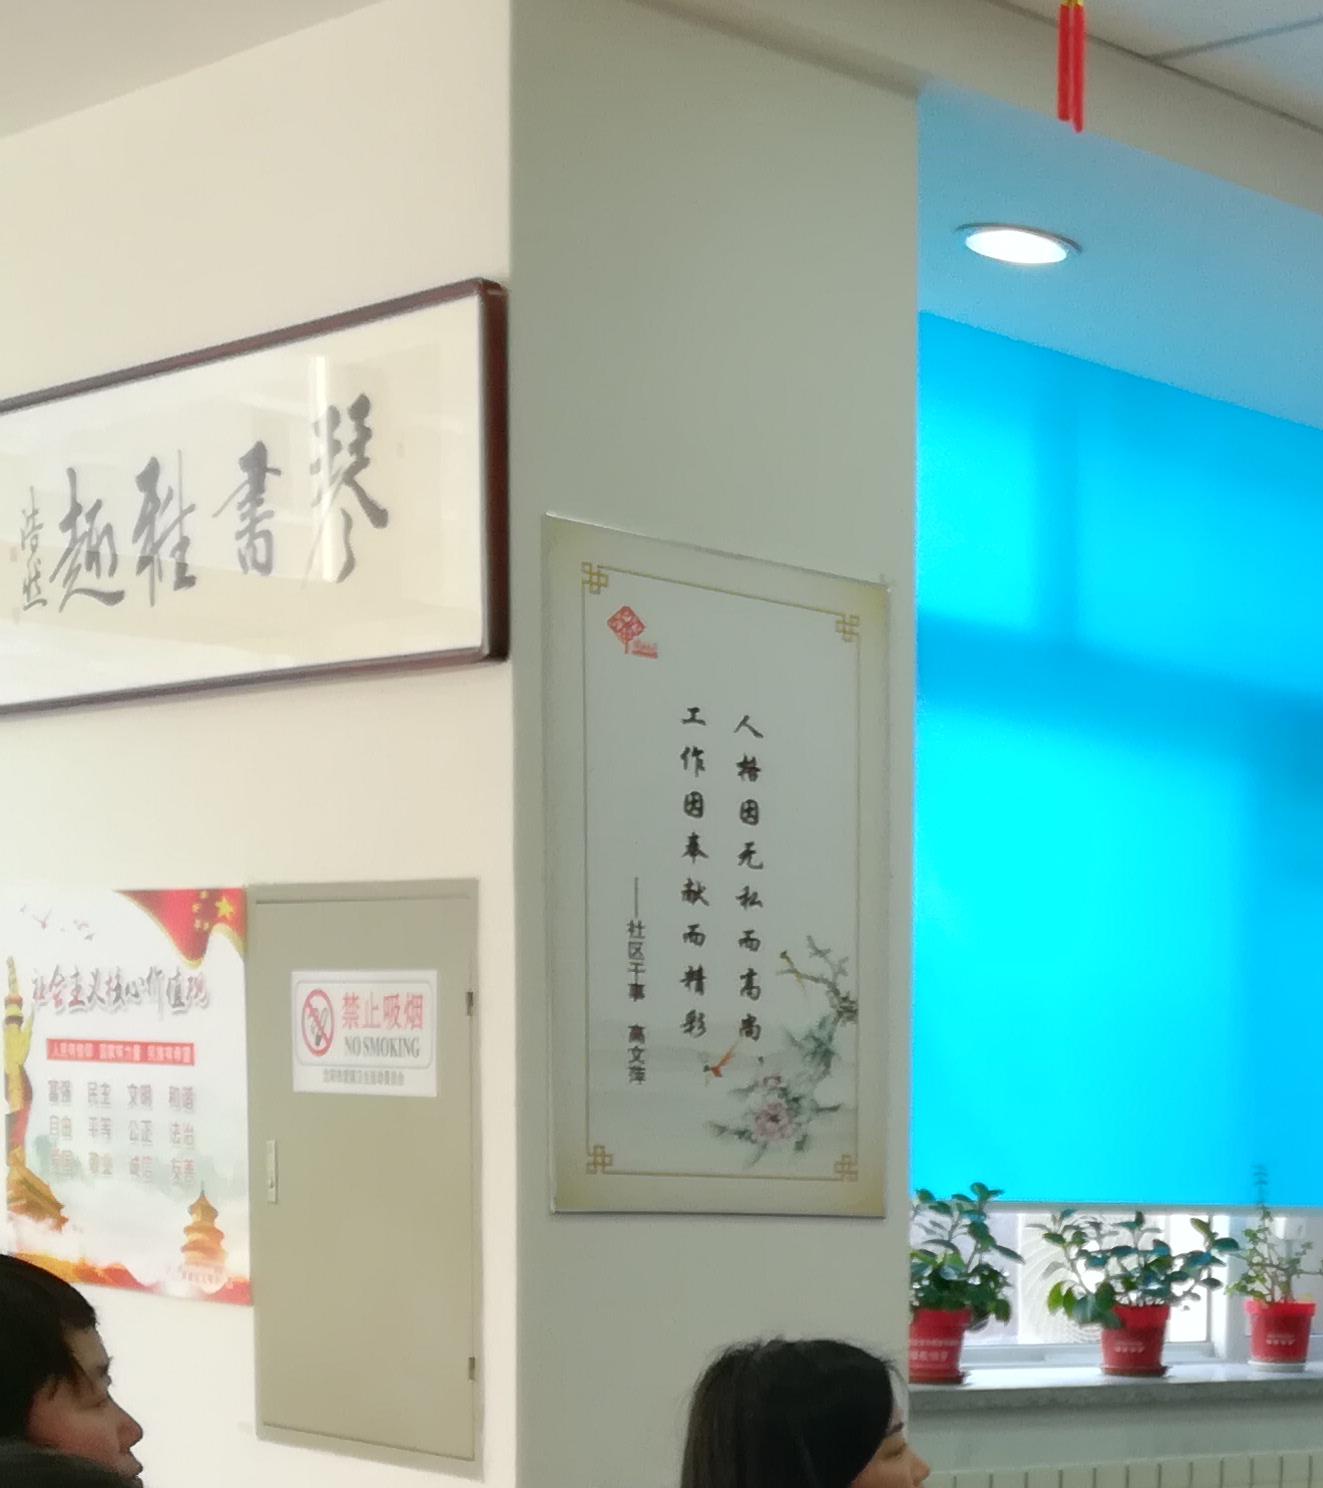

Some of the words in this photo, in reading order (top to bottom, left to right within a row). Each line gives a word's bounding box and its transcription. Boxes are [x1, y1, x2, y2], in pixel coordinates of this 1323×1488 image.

[681, 706, 710, 1038] 工作因奉献而精彩
[342, 991, 424, 1030] 禁止吸烟
[344, 1035, 361, 1057] NO
[362, 1036, 421, 1058] SMOKING
